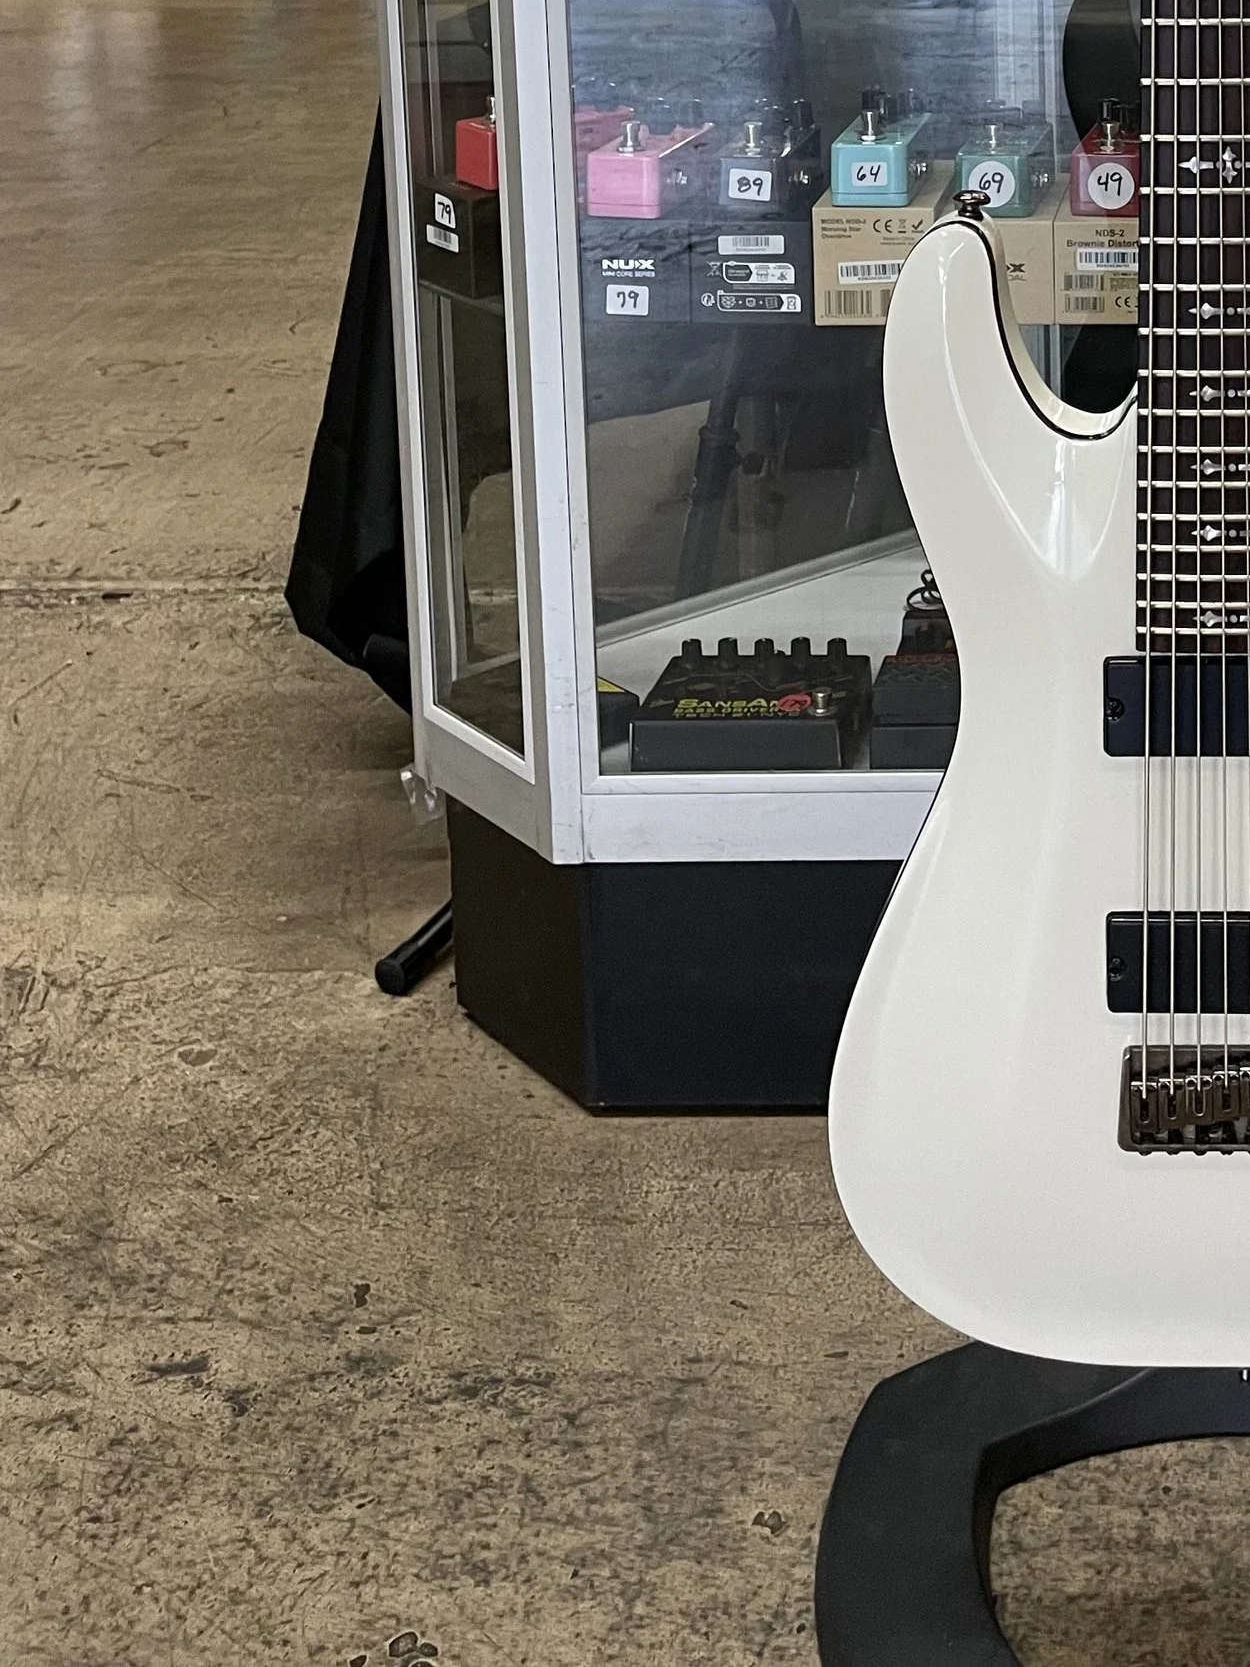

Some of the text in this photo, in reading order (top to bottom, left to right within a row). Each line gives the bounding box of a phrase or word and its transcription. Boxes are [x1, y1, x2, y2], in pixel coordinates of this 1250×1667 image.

[856, 164, 881, 183] 64
[978, 171, 1004, 194] 69
[736, 176, 763, 197] 89
[1097, 171, 1123, 197] 49
[437, 202, 451, 224] 79
[1095, 229, 1125, 237] NDS-2
[1066, 239, 1140, 248] Brownie Distort
[602, 259, 656, 270] NUX
[616, 290, 640, 309] 79
